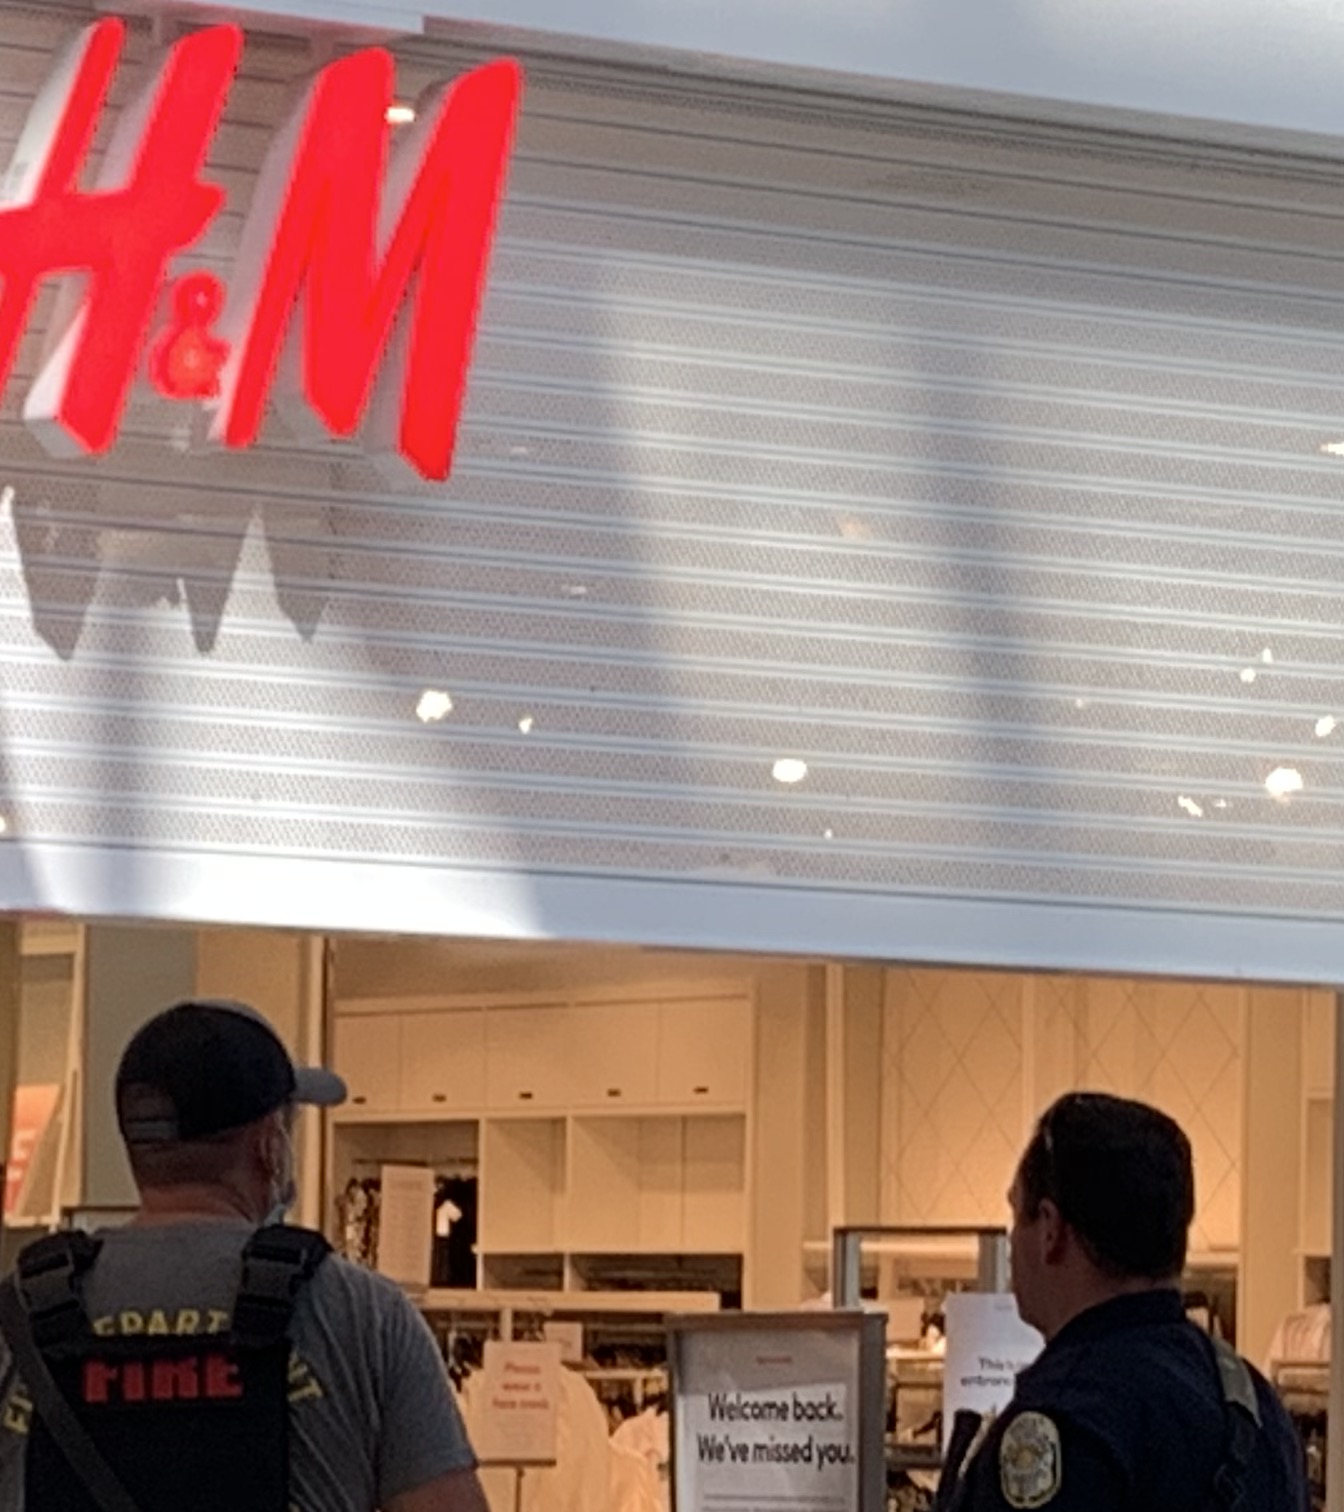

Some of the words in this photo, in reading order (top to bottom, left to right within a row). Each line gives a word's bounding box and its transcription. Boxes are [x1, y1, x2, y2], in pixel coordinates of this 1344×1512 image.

[708, 1392, 790, 1422] Welcome
[792, 1391, 843, 1422] back.
[697, 1433, 749, 1463] We've
[752, 1433, 812, 1463] missed
[816, 1442, 855, 1471] you.
